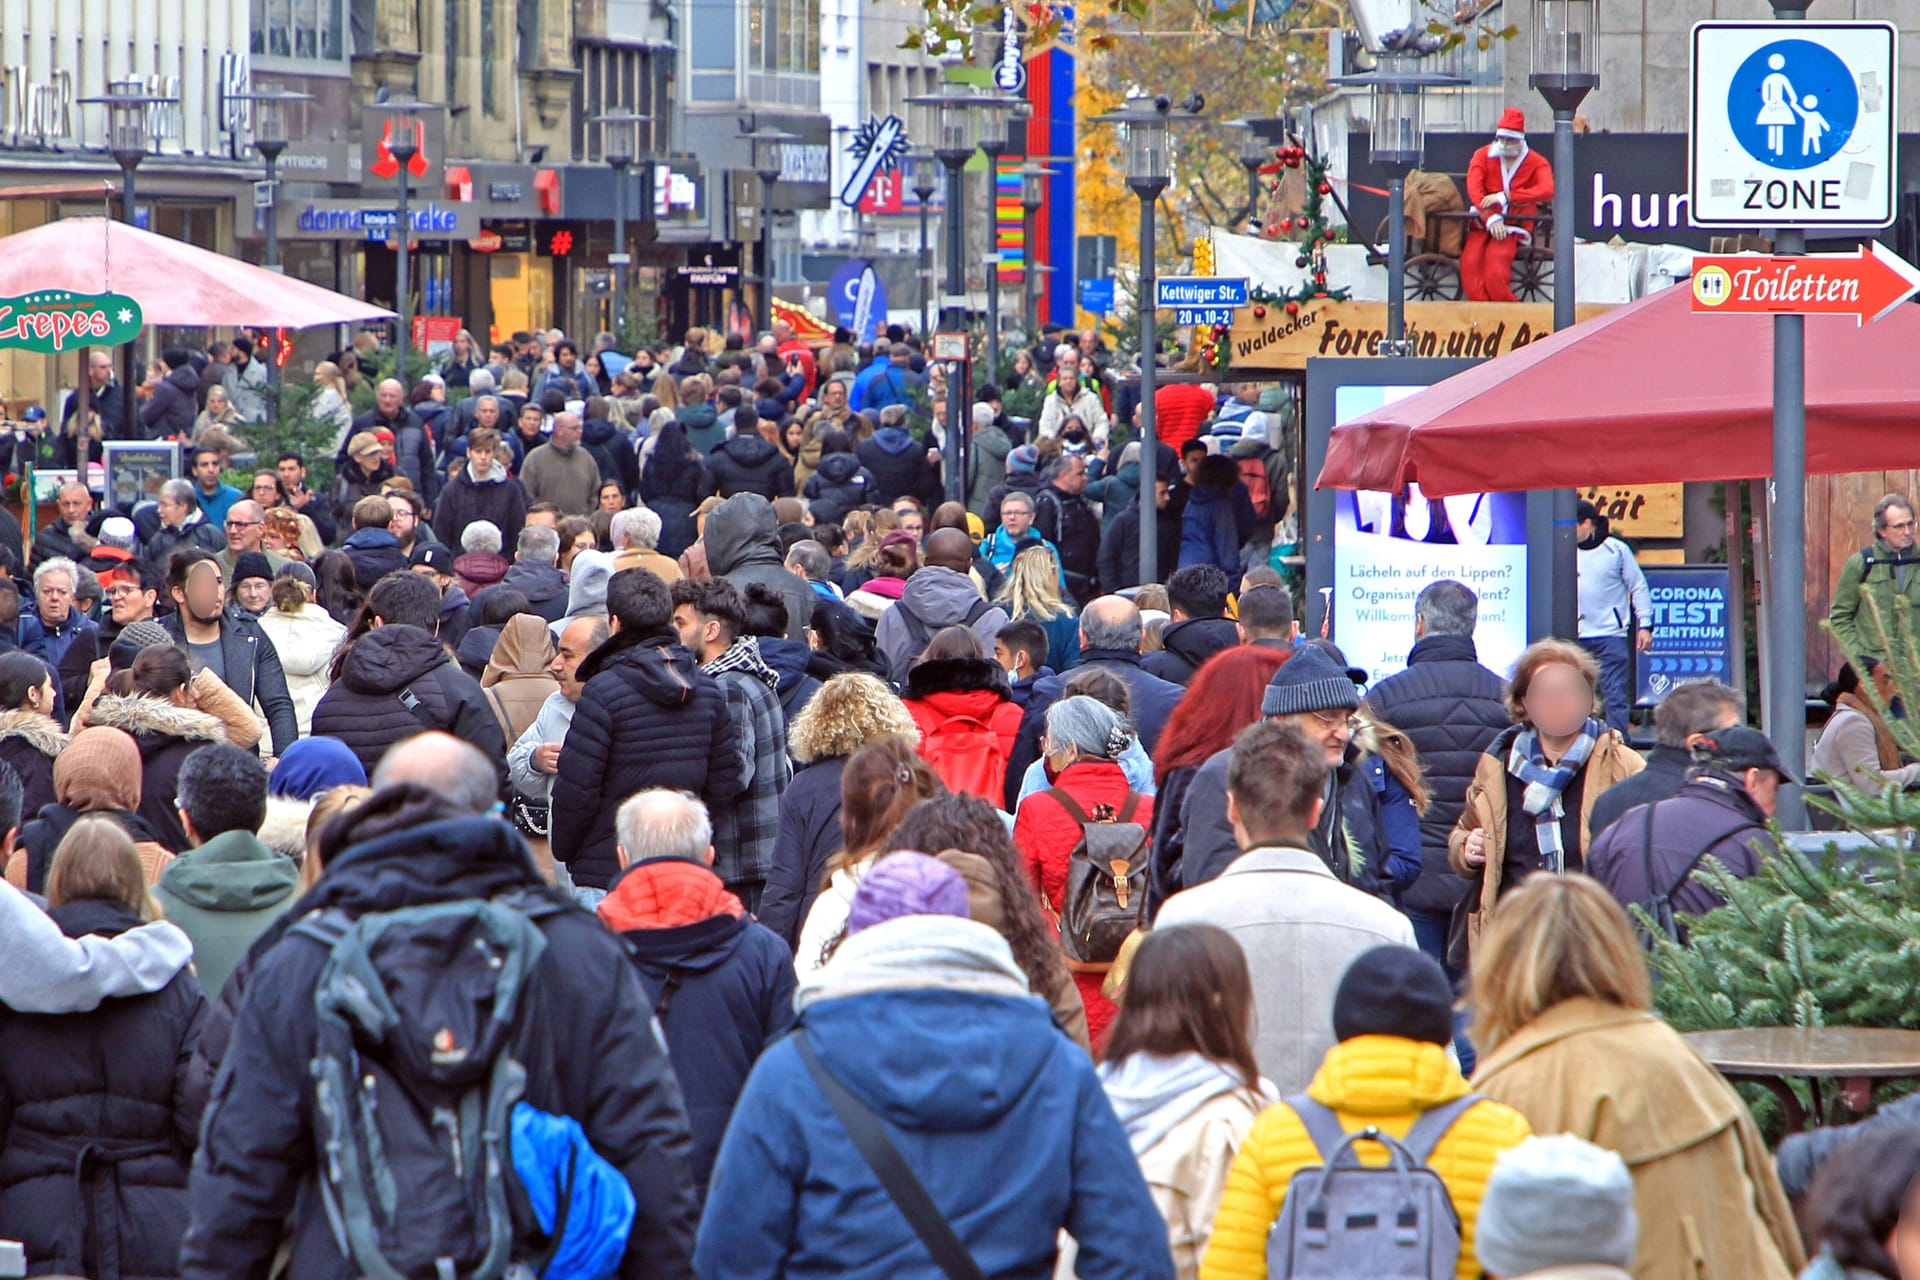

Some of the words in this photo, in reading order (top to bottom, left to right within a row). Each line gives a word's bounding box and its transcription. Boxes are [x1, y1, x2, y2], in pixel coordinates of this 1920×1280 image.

[1743, 179, 1841, 209] ZONE
[1733, 264, 1861, 301] Toiletten
[1161, 284, 1215, 303] Kettwiger
[1219, 284, 1240, 300] Str.
[1179, 310, 1192, 324] 20
[1237, 310, 1319, 357] Waldecker
[1446, 321, 1505, 357] und
[1350, 564, 1401, 578] Lächeln
[1405, 564, 1427, 578] auf
[1432, 564, 1456, 578] den
[1461, 564, 1513, 583] Lippen?
[1650, 587, 1723, 600] CORONA
[1652, 602, 1725, 624] TEST
[1652, 626, 1725, 638] ZENTRUM
